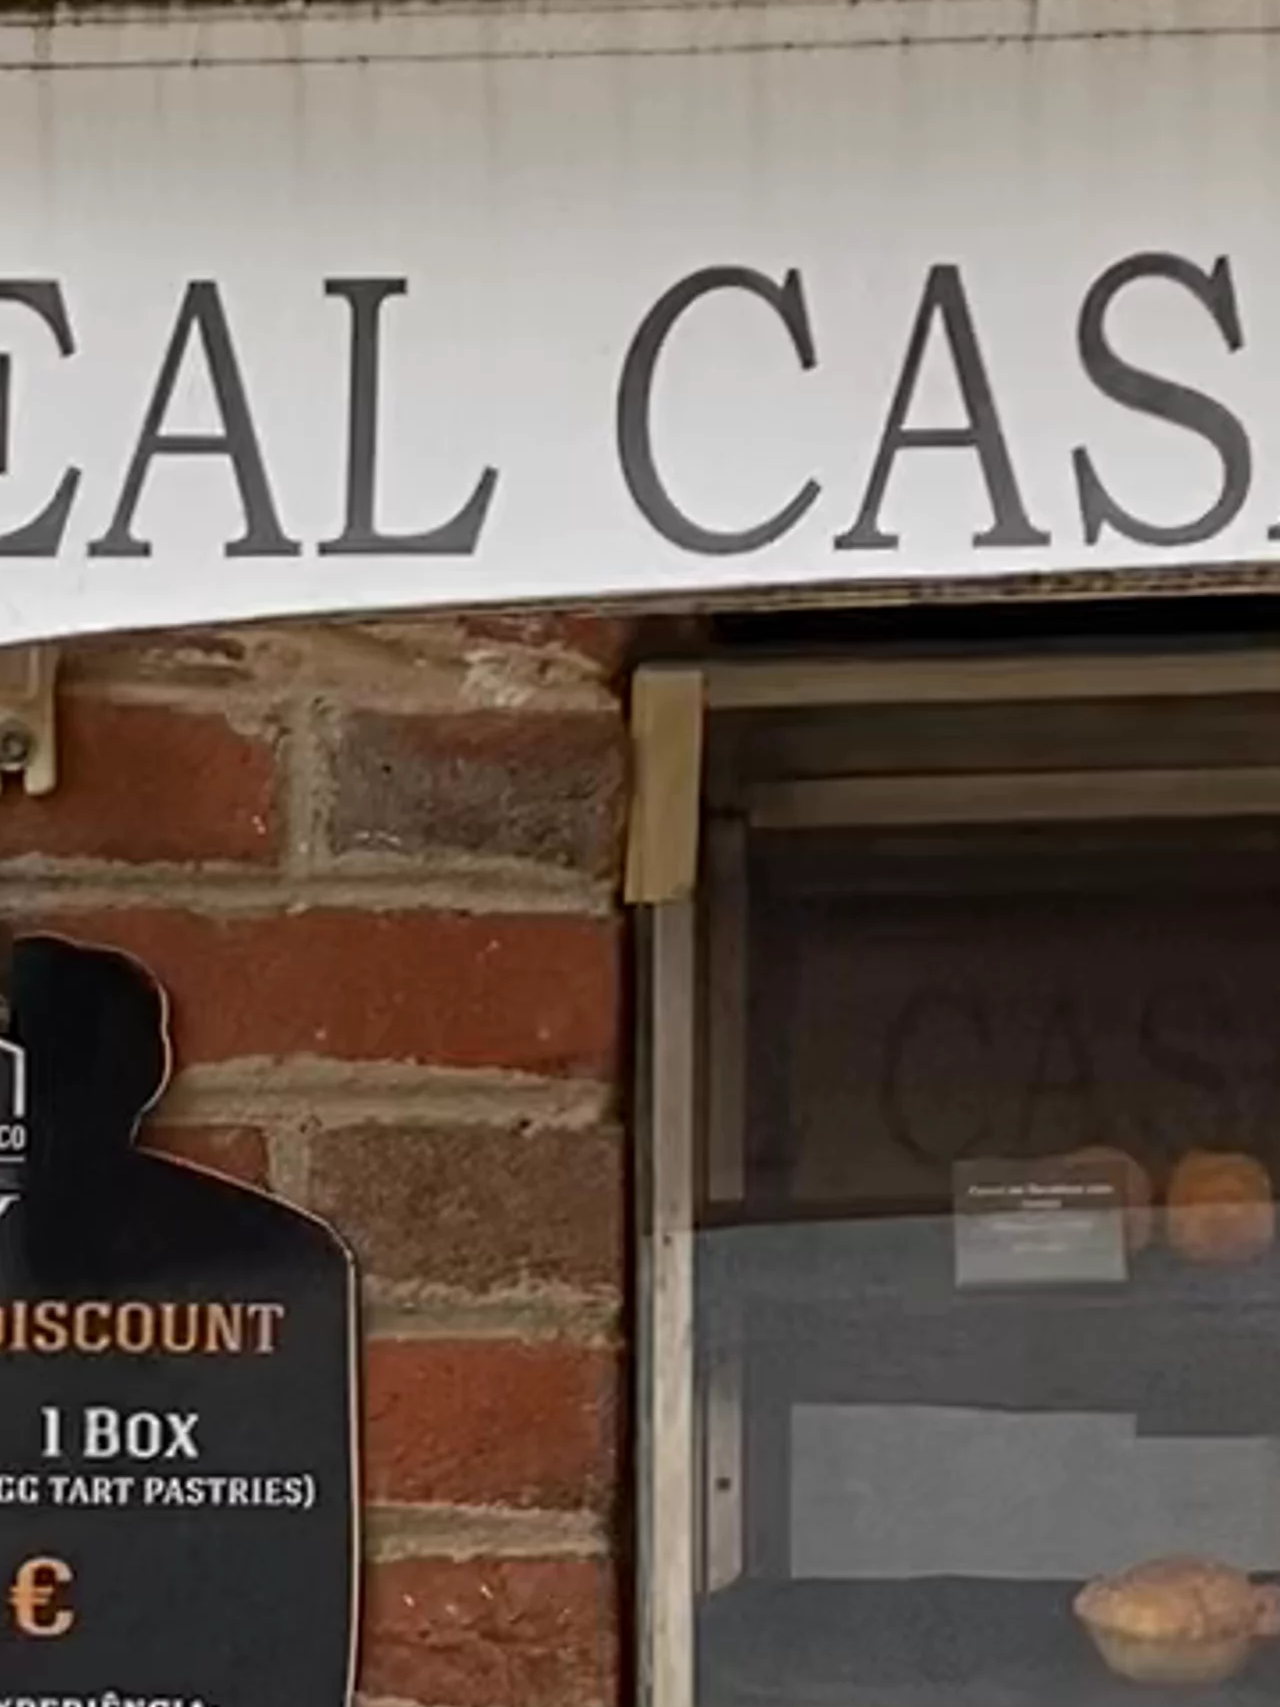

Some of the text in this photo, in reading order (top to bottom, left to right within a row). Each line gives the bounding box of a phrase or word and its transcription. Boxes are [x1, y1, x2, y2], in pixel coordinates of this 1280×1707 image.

[40, 1406, 200, 1459] 1 BOX
[48, 1475, 135, 1505] TART
[143, 1474, 317, 1509] PASTRIES)
[8, 1557, 75, 1637] €
